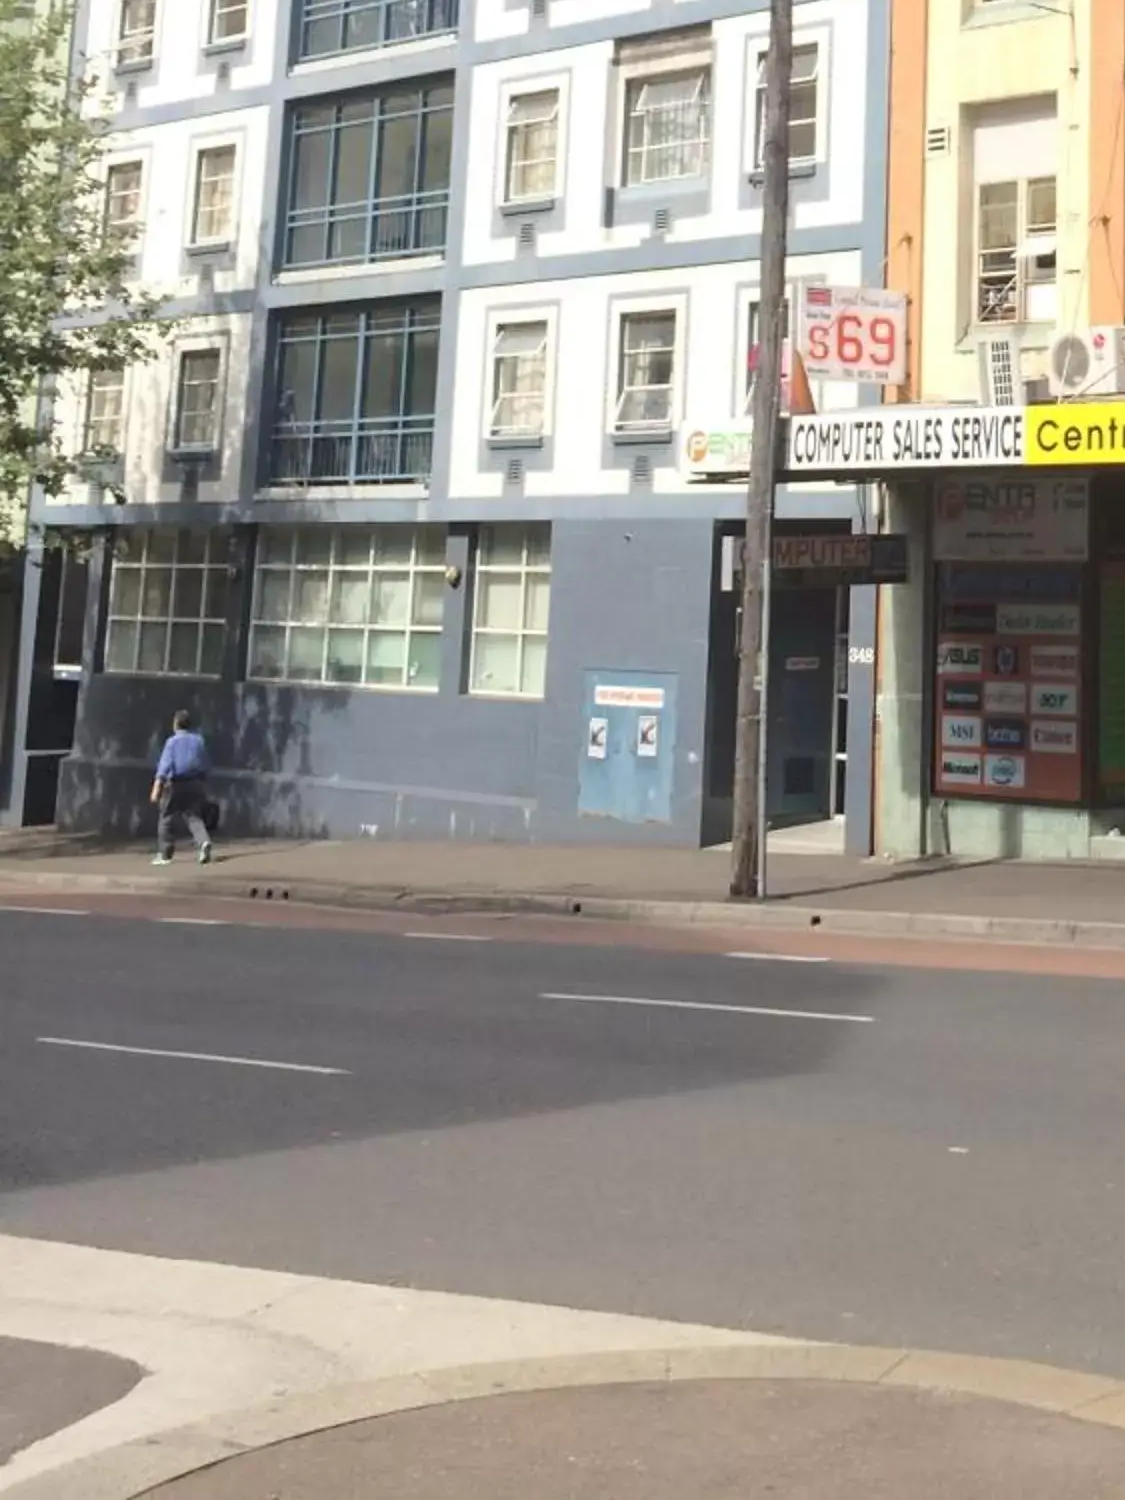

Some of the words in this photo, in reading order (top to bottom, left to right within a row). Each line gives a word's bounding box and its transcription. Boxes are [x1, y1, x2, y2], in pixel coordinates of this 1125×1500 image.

[794, 420, 884, 464] COMPUTER
[893, 417, 944, 461] SALES
[951, 415, 1023, 459] SERVICE
